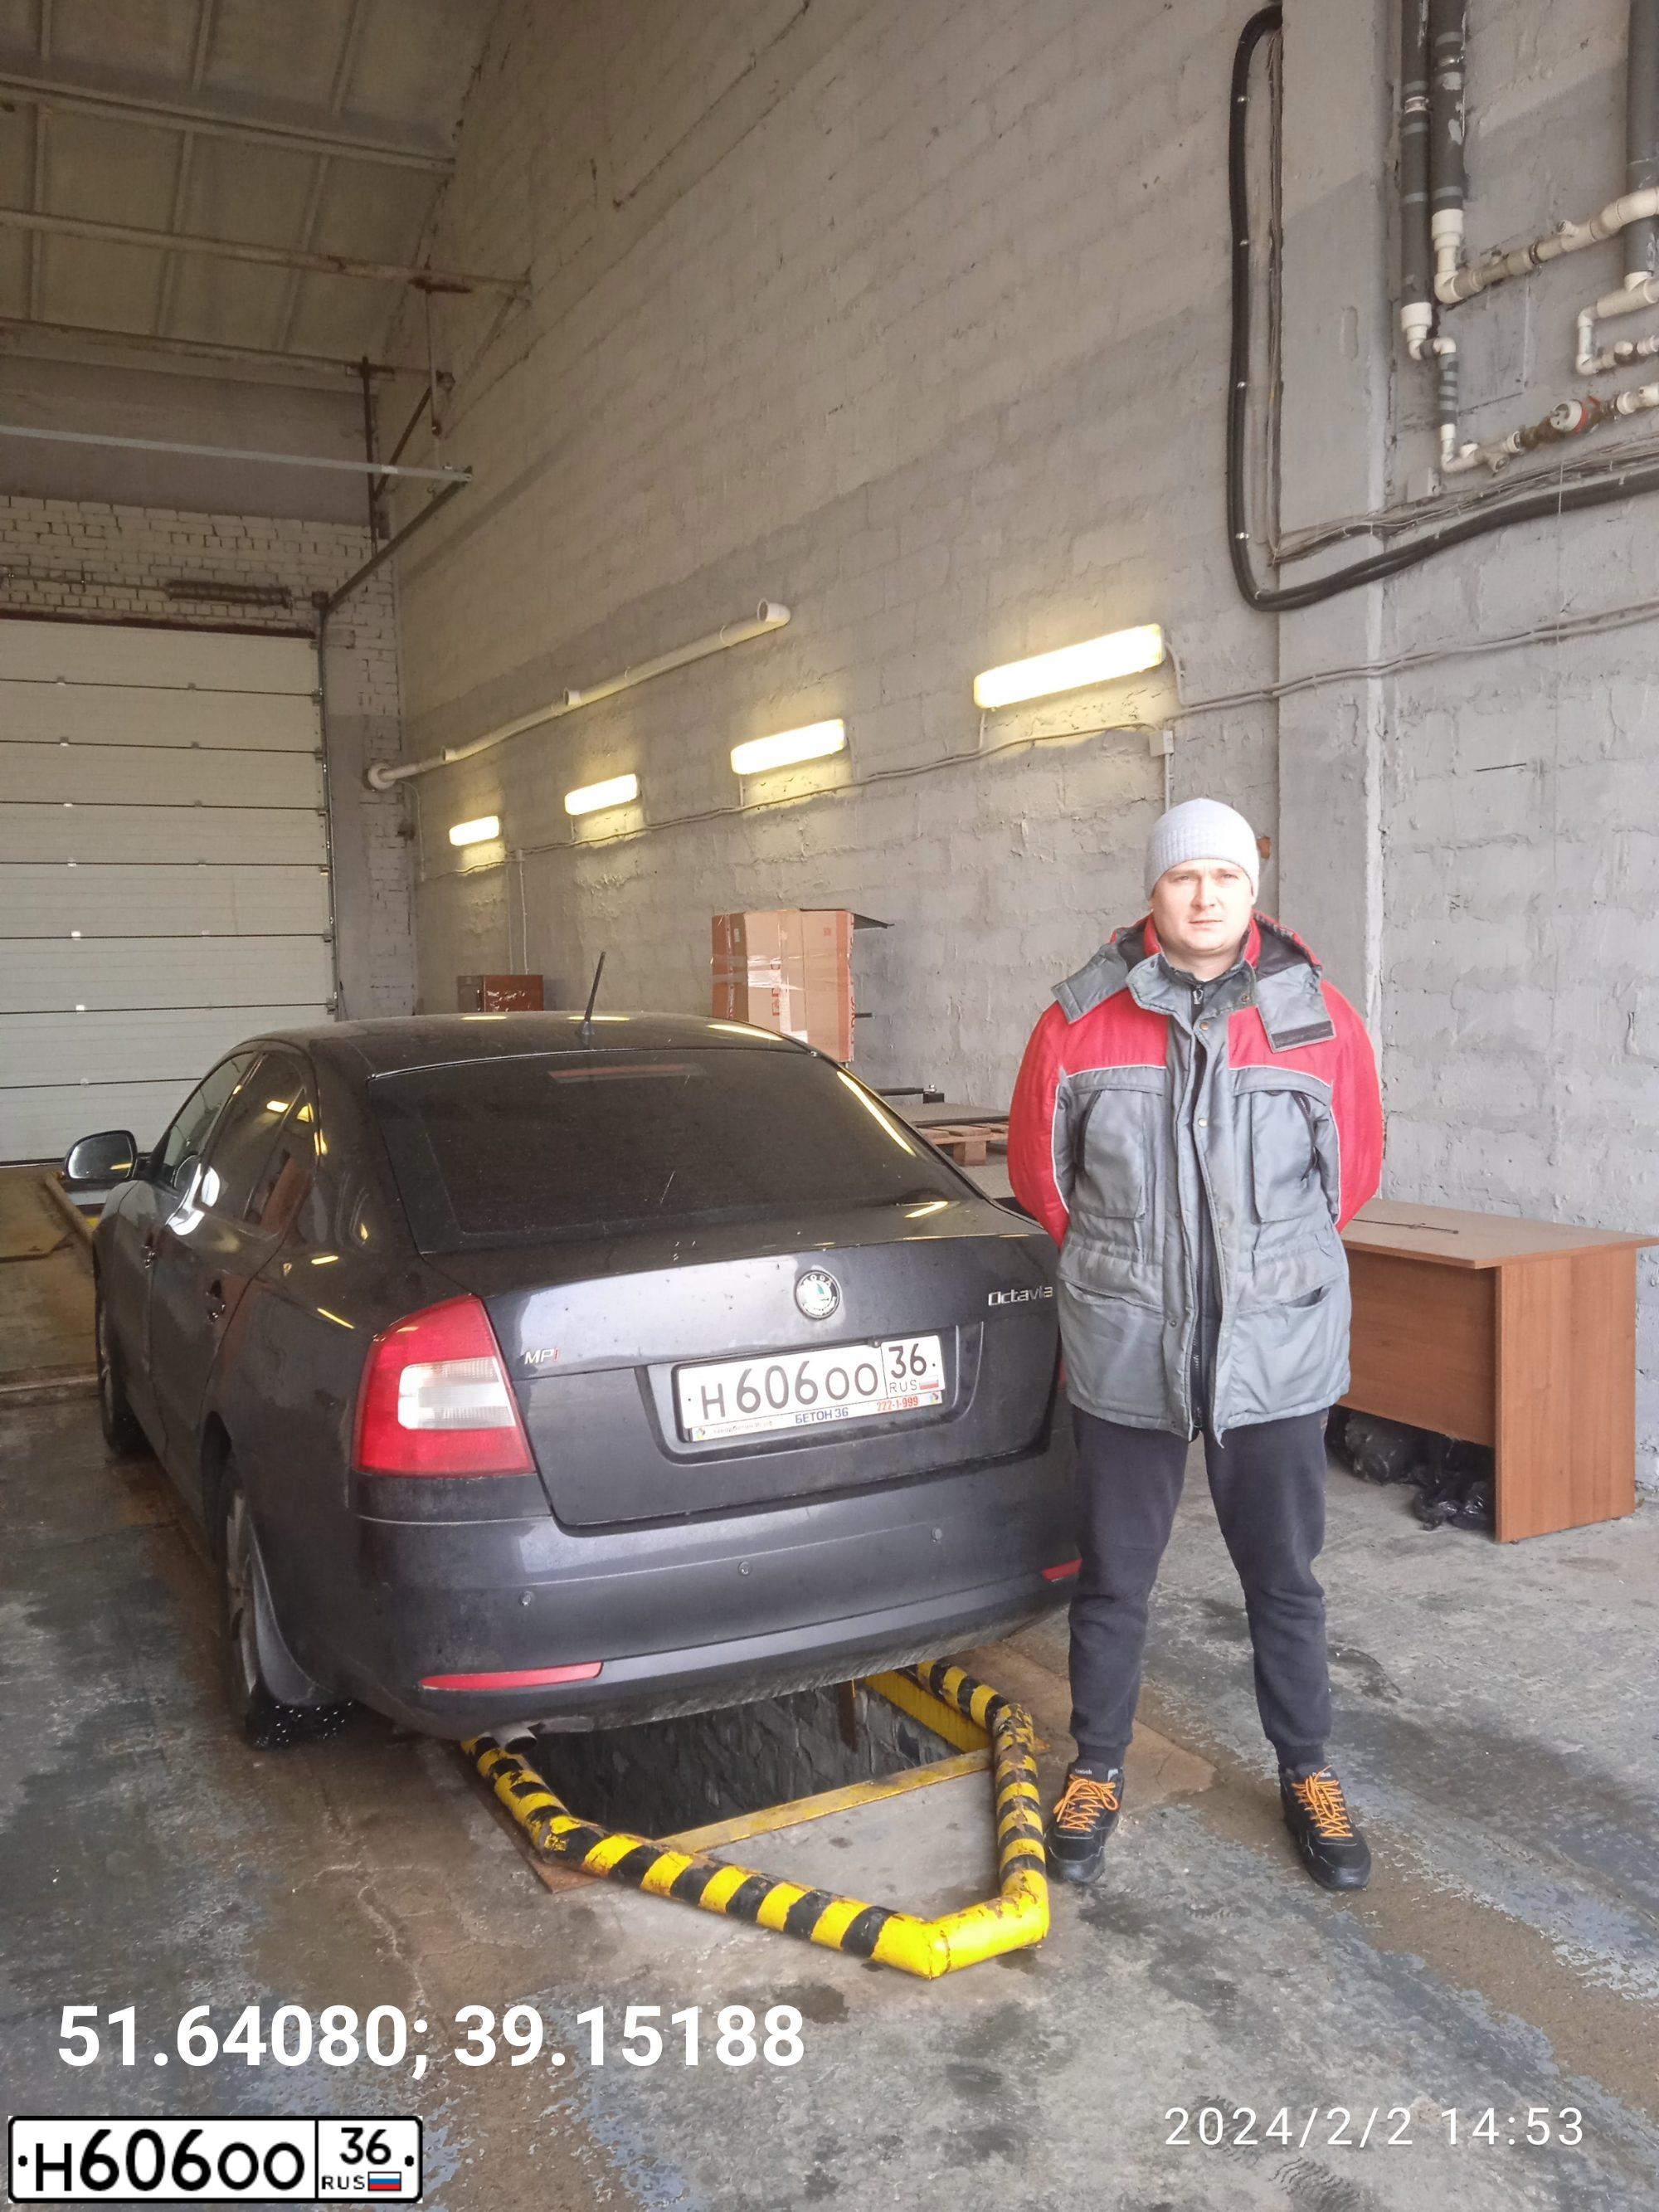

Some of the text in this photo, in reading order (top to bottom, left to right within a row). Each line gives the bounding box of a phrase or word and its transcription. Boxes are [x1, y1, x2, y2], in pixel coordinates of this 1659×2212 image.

[988, 1285, 1053, 1306] Octavia
[888, 1342, 927, 1379] 36
[889, 1379, 917, 1394] RUS
[795, 1407, 849, 1424] БЕТОН 36
